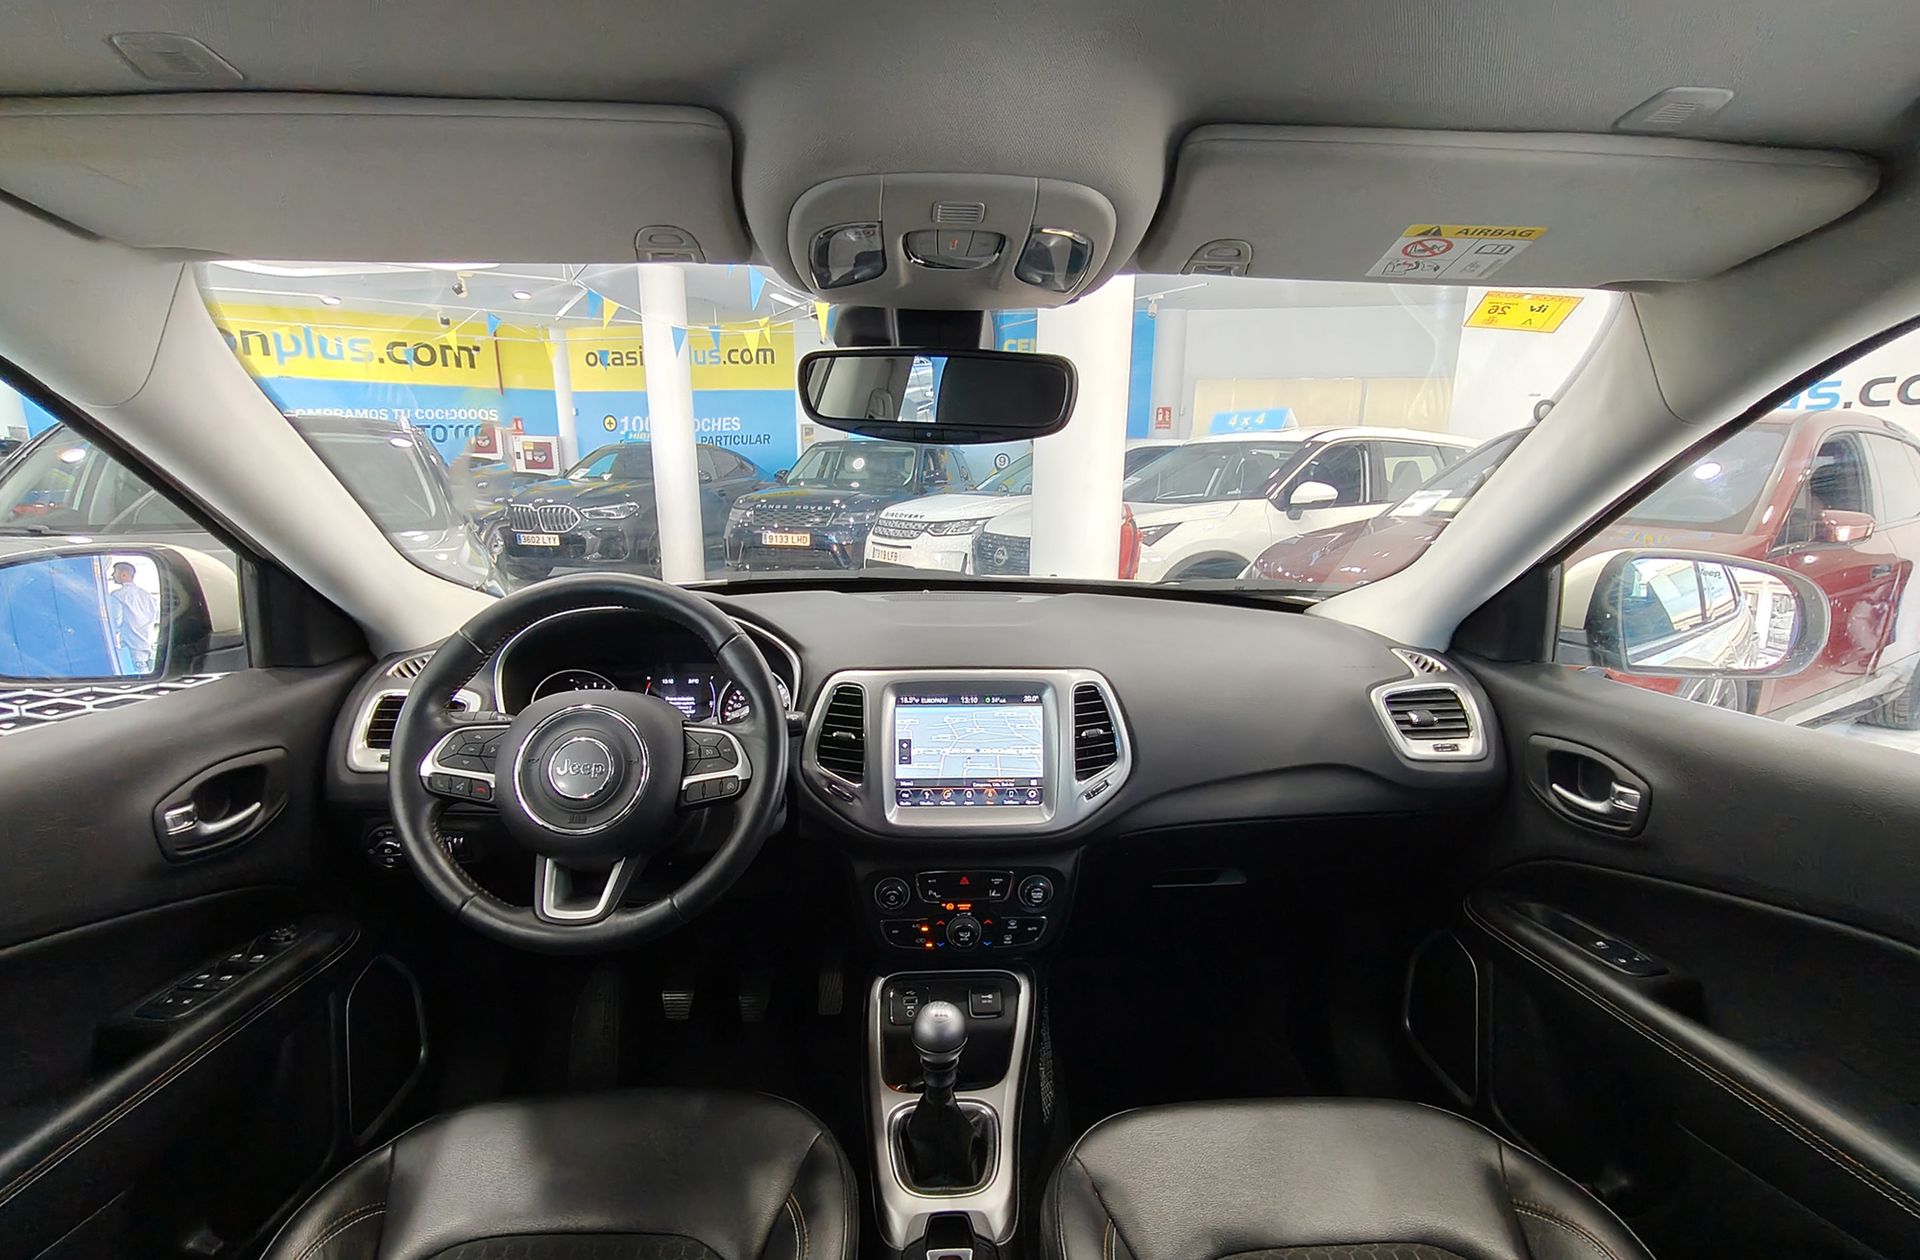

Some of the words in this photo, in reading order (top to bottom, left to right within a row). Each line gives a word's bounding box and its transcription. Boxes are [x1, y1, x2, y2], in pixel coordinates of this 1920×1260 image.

[1456, 227, 1535, 239] AIRBAG
[701, 433, 771, 447] PARTICULAR
[997, 455, 1007, 467] 9
[768, 534, 789, 545] 9133
[556, 758, 606, 779] Jeep
